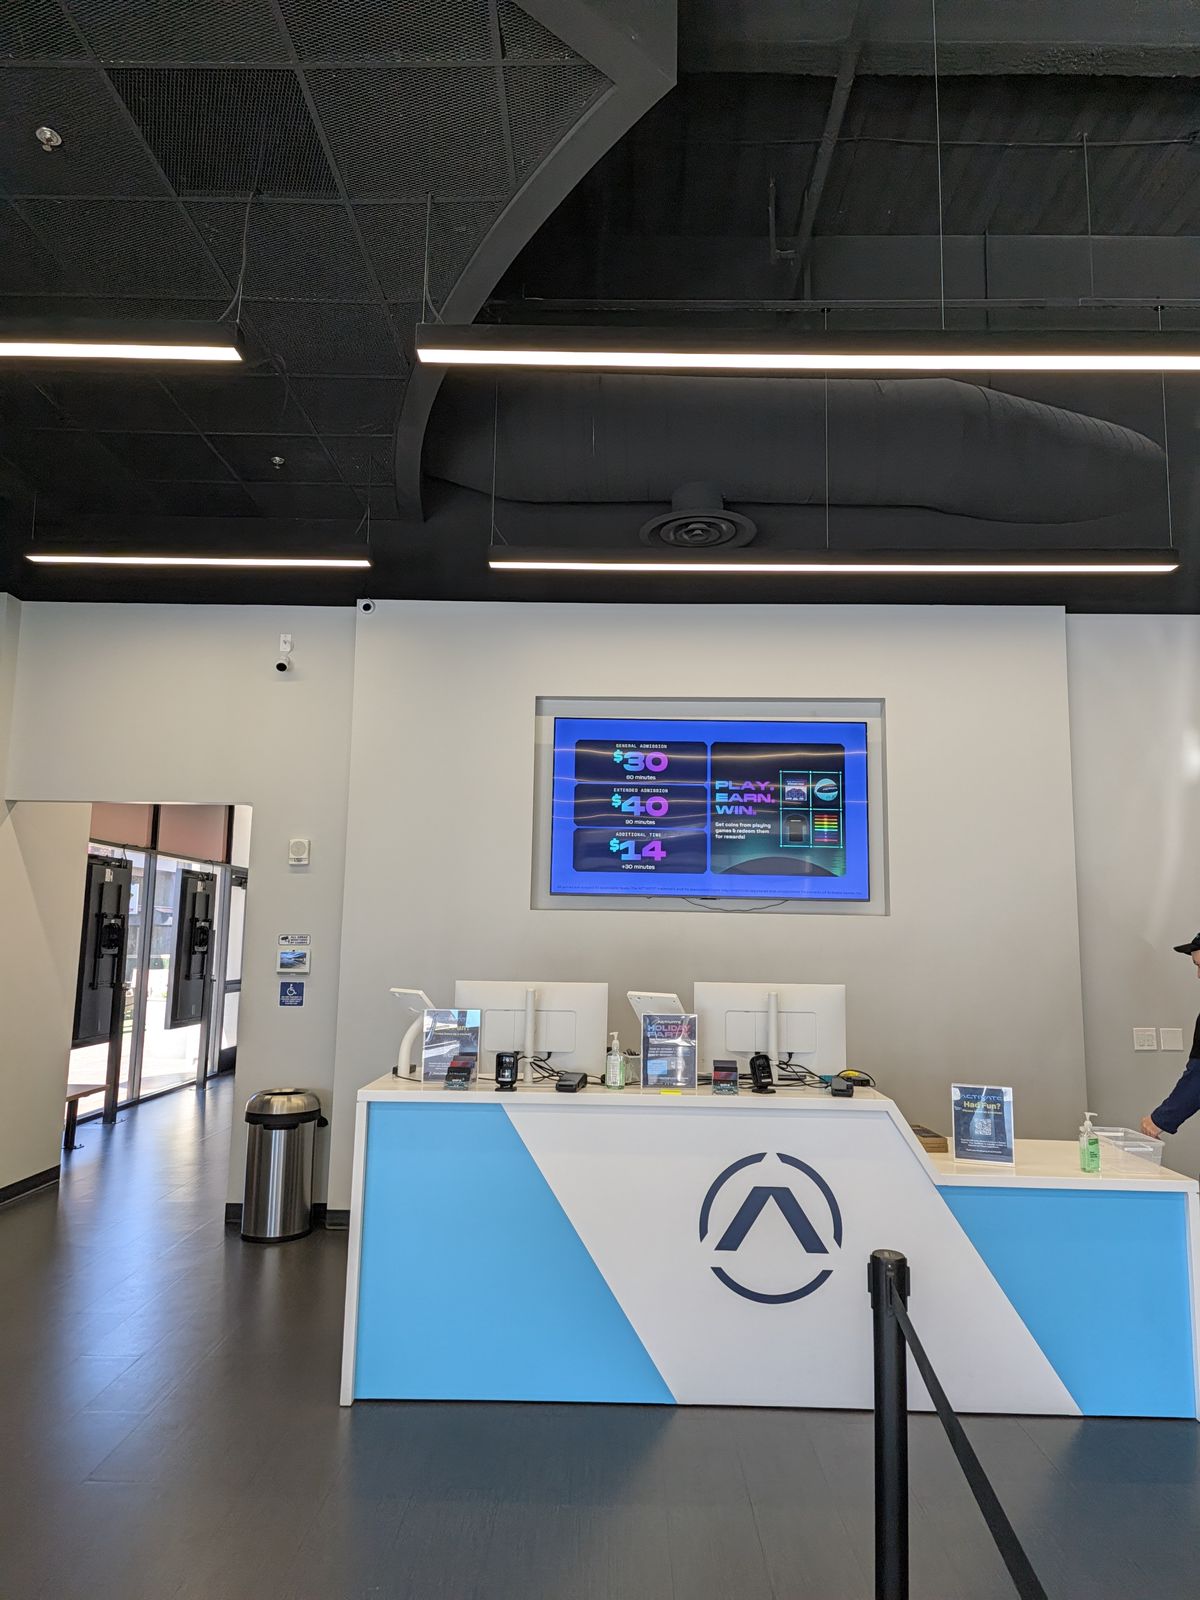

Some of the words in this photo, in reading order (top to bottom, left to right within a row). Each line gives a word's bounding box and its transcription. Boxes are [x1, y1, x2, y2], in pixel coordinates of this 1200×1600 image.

[613, 749, 669, 773] $30
[715, 780, 775, 791] PLAY.
[715, 793, 776, 804] EARN.
[611, 793, 669, 817] $40
[715, 805, 757, 816] WIN.
[609, 838, 667, 861] $14
[647, 1024, 692, 1032] HOLIDAY
[963, 1100, 981, 1109] Had
[981, 1101, 1001, 1110] Fun?
